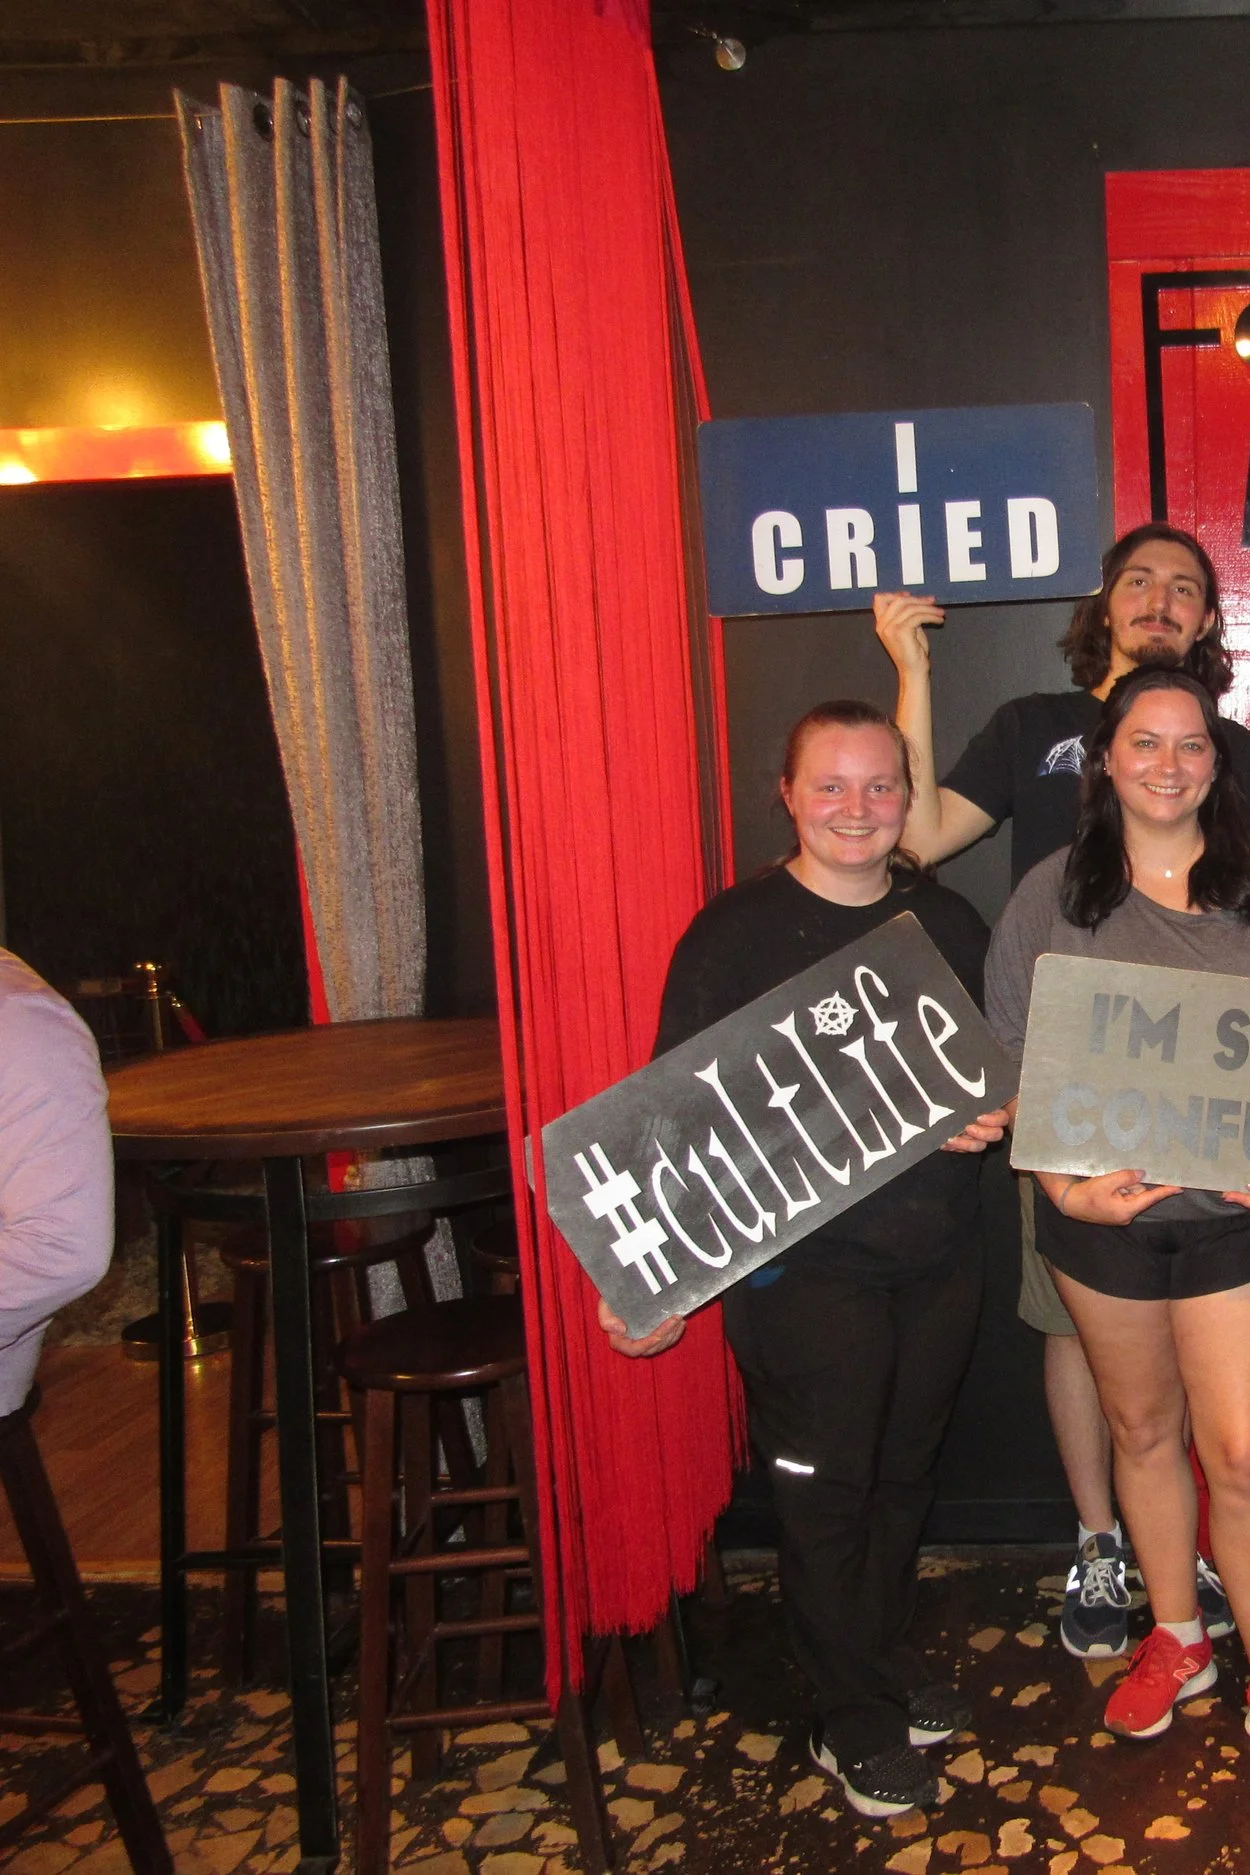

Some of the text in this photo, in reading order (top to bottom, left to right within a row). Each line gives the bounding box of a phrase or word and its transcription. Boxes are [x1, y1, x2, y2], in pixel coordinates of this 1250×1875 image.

[895, 422, 917, 493] I
[751, 497, 1061, 596] CRIED
[1089, 992, 1181, 1064] I'M
